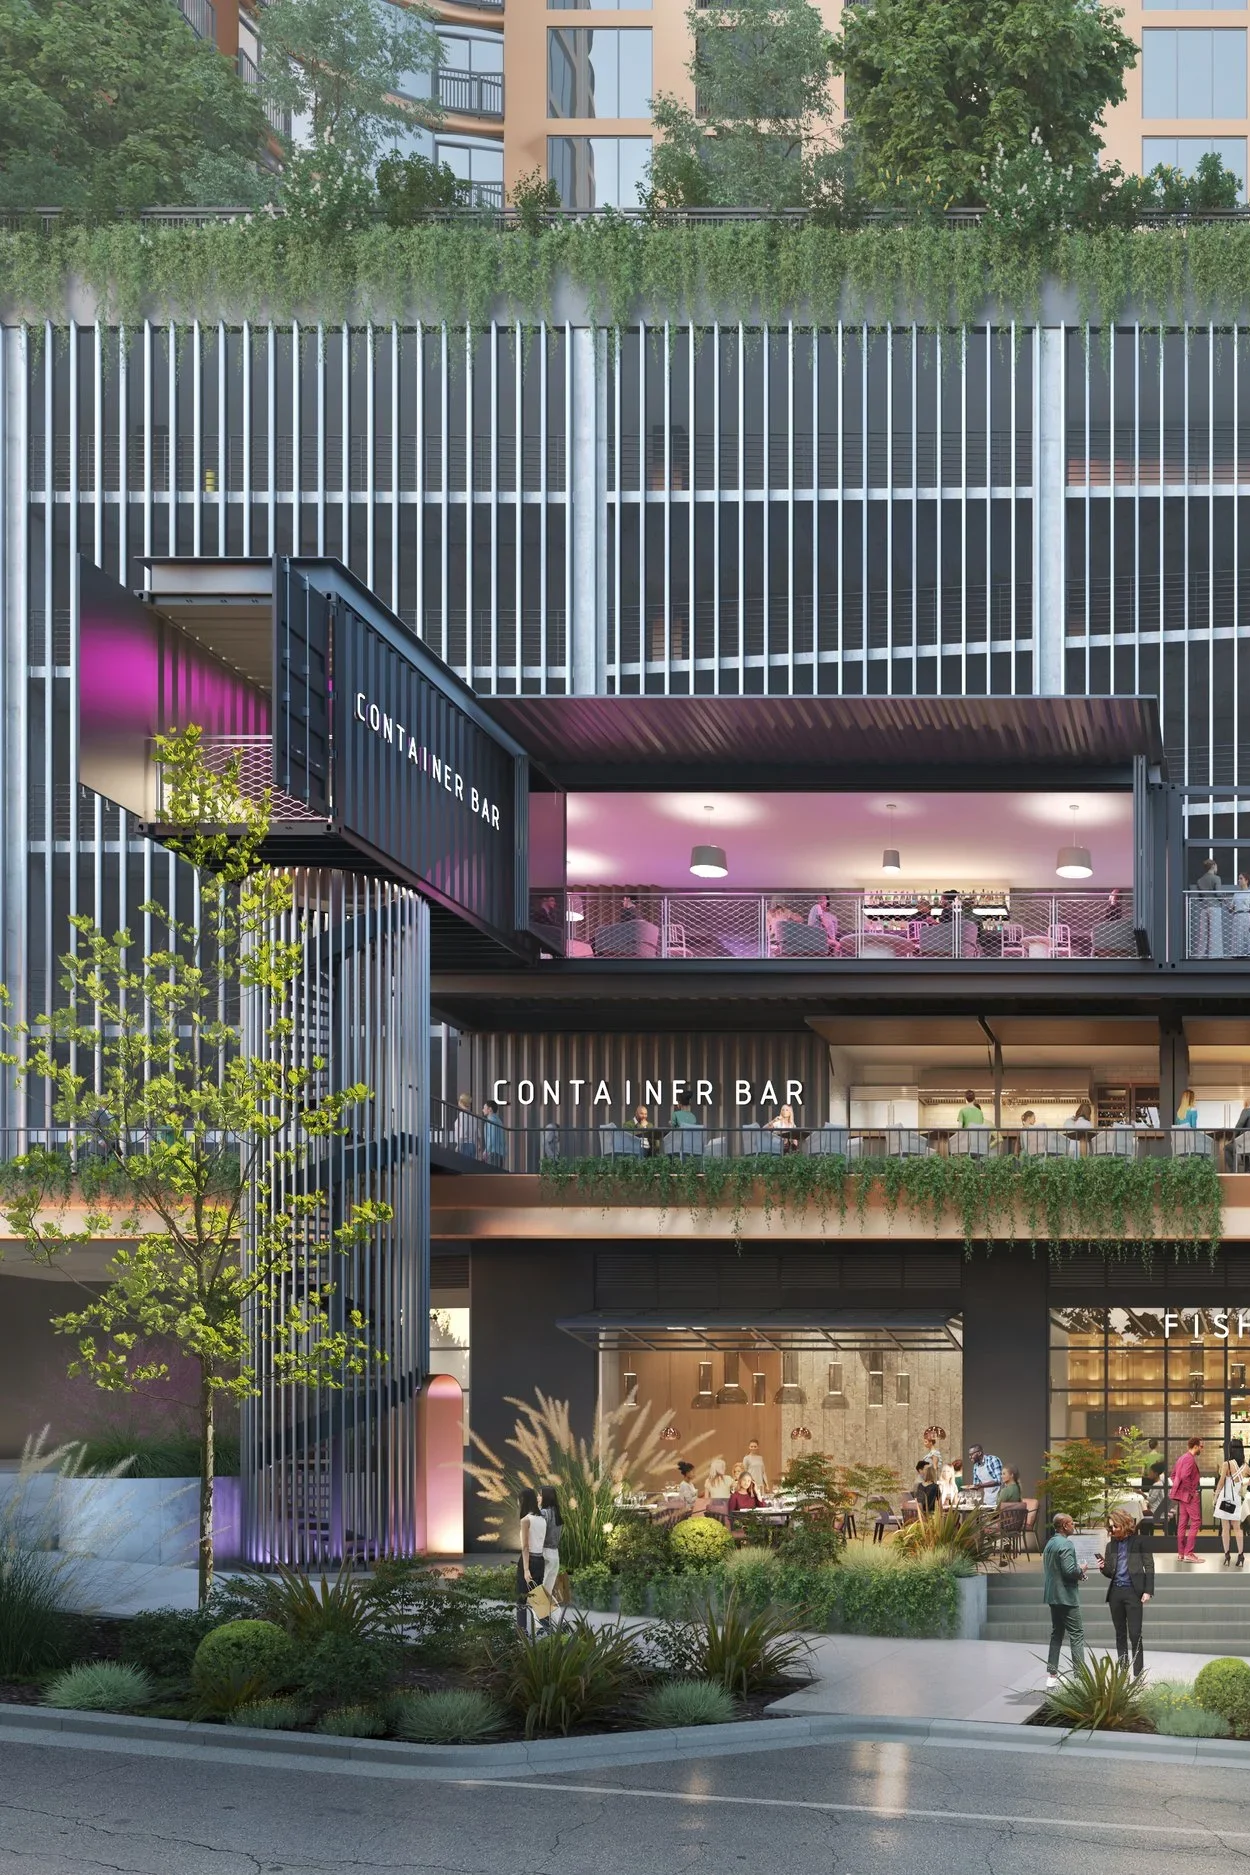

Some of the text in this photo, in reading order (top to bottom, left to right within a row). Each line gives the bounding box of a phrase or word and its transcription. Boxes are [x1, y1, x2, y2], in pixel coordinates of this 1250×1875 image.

[356, 692, 499, 830] CONTAINER BAR
[493, 1079, 804, 1105] CONTAINER BAR
